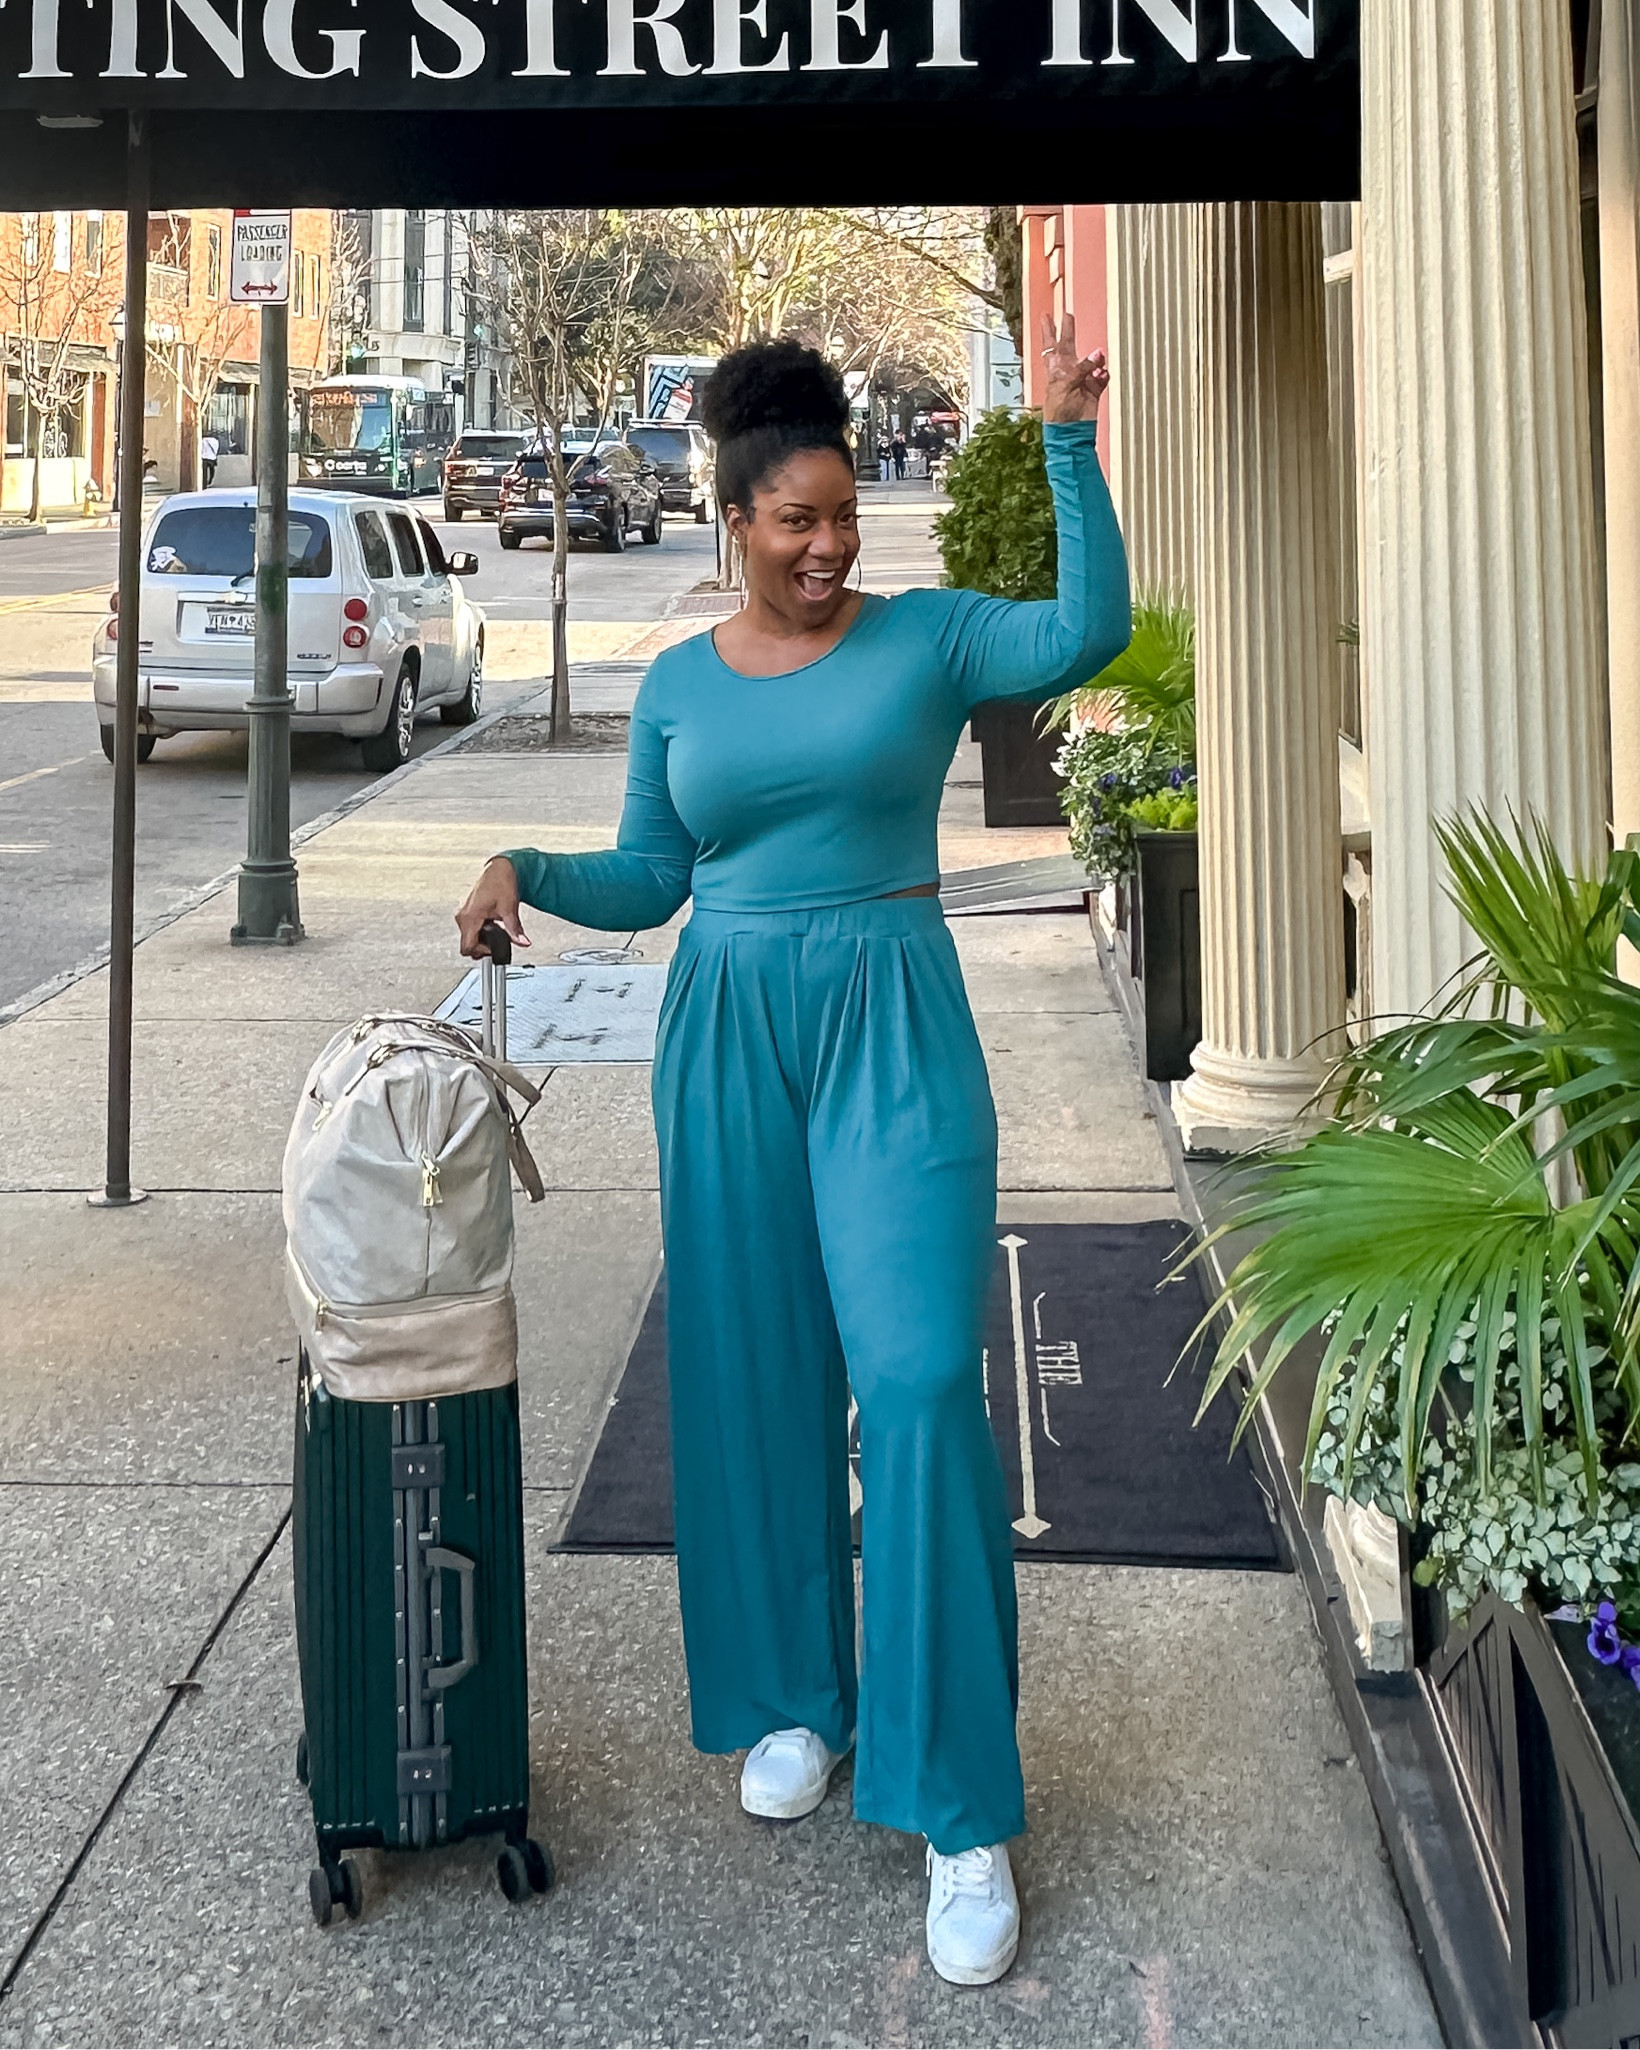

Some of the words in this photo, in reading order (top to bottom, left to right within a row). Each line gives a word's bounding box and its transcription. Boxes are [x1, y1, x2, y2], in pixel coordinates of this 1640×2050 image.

[411, 0, 977, 79] STREET
[1040, 0, 1316, 66] INN
[237, 224, 288, 241] PASSENGER
[241, 245, 283, 262] LOADING
